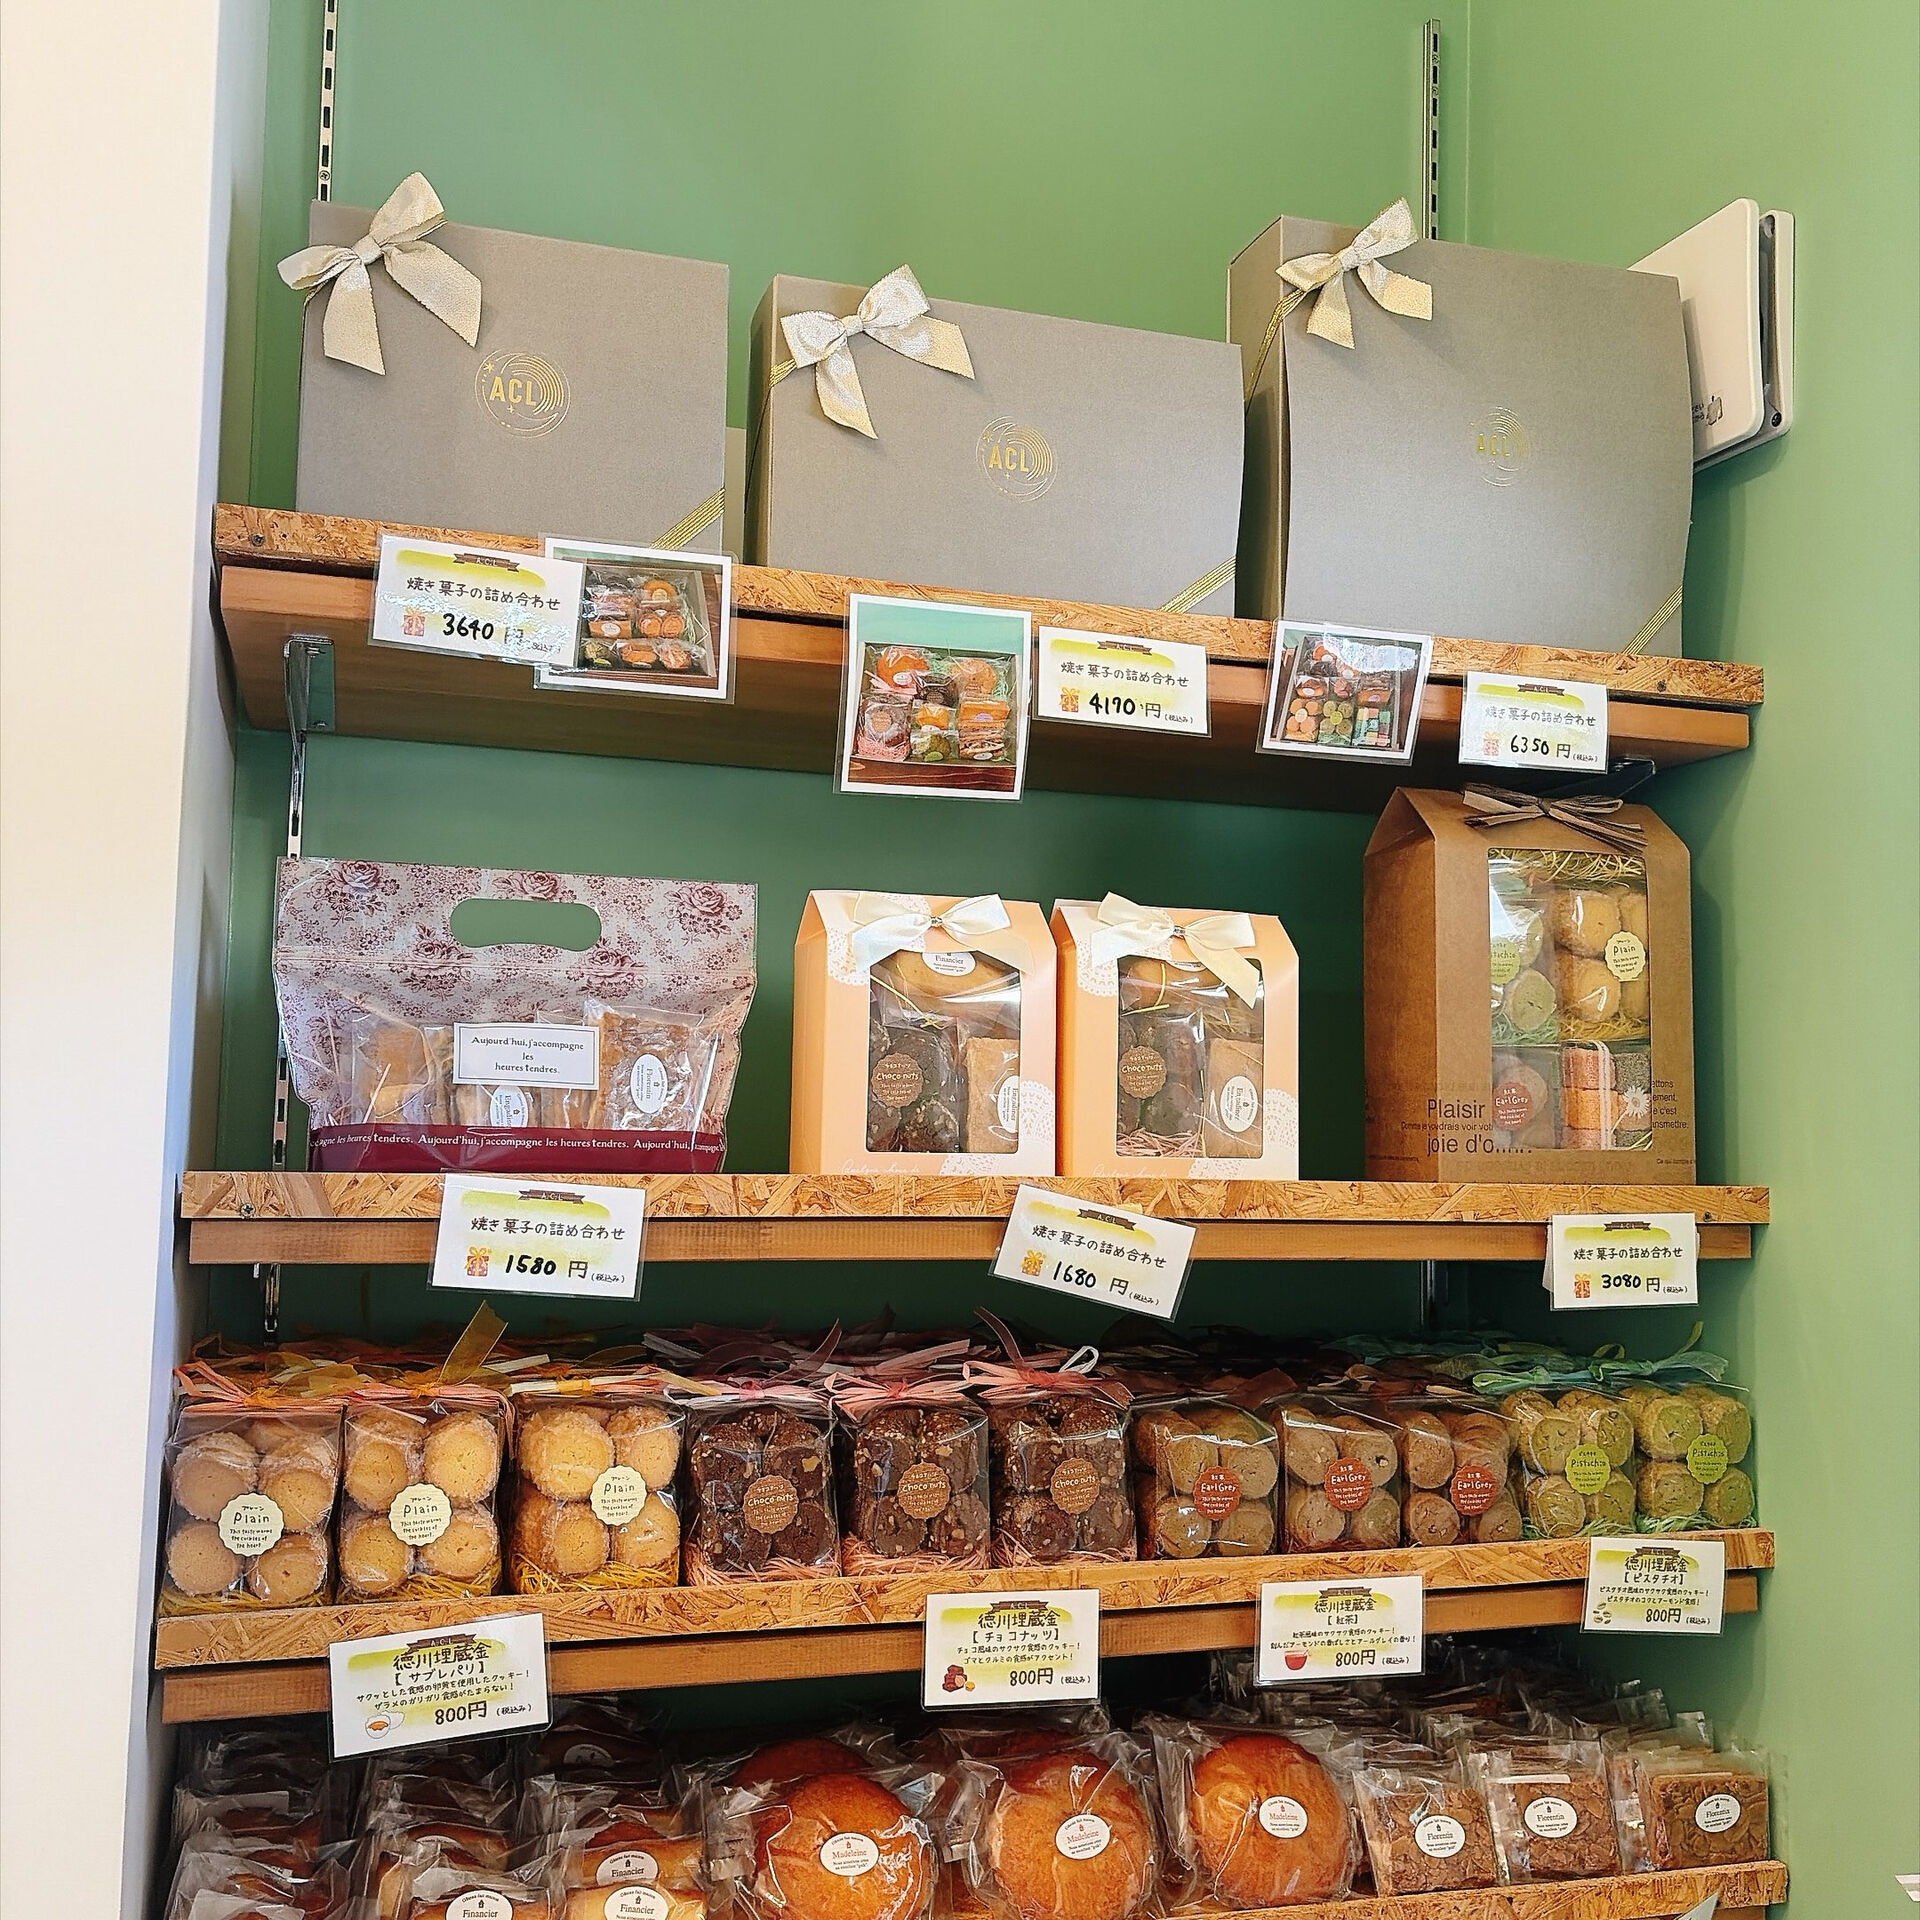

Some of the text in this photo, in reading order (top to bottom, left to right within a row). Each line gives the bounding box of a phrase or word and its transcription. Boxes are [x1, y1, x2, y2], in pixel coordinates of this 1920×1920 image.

[489, 376, 537, 406] ACL
[1476, 433, 1510, 456] ACL
[988, 444, 1029, 472] ACL
[407, 576, 561, 612] 焼き菓子の詰め合わせ
[443, 613, 494, 640] 3640
[1061, 661, 1190, 688] 焼き菓子の詰め合わせ
[1145, 703, 1161, 718] 円
[1485, 706, 1597, 727] 焼き菓子の詰め合わせ
[1510, 735, 1549, 755] 6350
[1556, 743, 1571, 759] 円
[1613, 945, 1636, 956] Plain
[528, 1038, 584, 1051] j'accompagne
[522, 1052, 533, 1060] les
[495, 1062, 560, 1074] heures tendres.
[1427, 1099, 1485, 1119] Plaisir
[1659, 1107, 1677, 1115] c'est
[1462, 1123, 1477, 1131] voir
[337, 1135, 346, 1144] les
[347, 1134, 371, 1143] heures
[374, 1133, 413, 1143] tendres.
[418, 1135, 480, 1146] Aujourd'hui,
[480, 1137, 543, 1149] j'accompagne
[546, 1138, 558, 1147] les
[560, 1138, 591, 1148] heures
[592, 1139, 629, 1149] tendres.
[1426, 1133, 1459, 1157] joie
[471, 1217, 626, 1240] 焼き菓子の詰め合わせ
[1032, 1224, 1167, 1269] 焼き菓子の詰め合わせ
[1573, 1246, 1683, 1261] 焼き菓子の詰め合わせ
[505, 1254, 625, 1284] 1580 円 (税込み)
[1052, 1261, 1160, 1306] 1680 円 (税込み)
[1601, 1274, 1641, 1289] 3080
[1646, 1277, 1660, 1293] 円
[1571, 1458, 1606, 1468] Pistachio
[603, 1482, 635, 1496] Plain
[233, 1511, 270, 1525] Plain
[403, 1504, 438, 1518] Plain
[1624, 1556, 1690, 1573] 徳川埋蔵金
[1314, 1598, 1377, 1613] 徳川埋蔵金
[978, 1610, 1061, 1629] 徳川埋蔵金
[1646, 1608, 1710, 1625] 800円 (税込み)
[393, 1642, 492, 1671] 徳川埋蔵金
[1335, 1649, 1410, 1667] 800円 (税込み)
[1010, 1667, 1091, 1687] 800円 (税込み)
[434, 1700, 532, 1725] 800円 (税込み)
[832, 1849, 867, 1859] Madeleine
[611, 1867, 645, 1878] Financier
[462, 1909, 499, 1918] Financier
[620, 1903, 655, 1915] Financier
